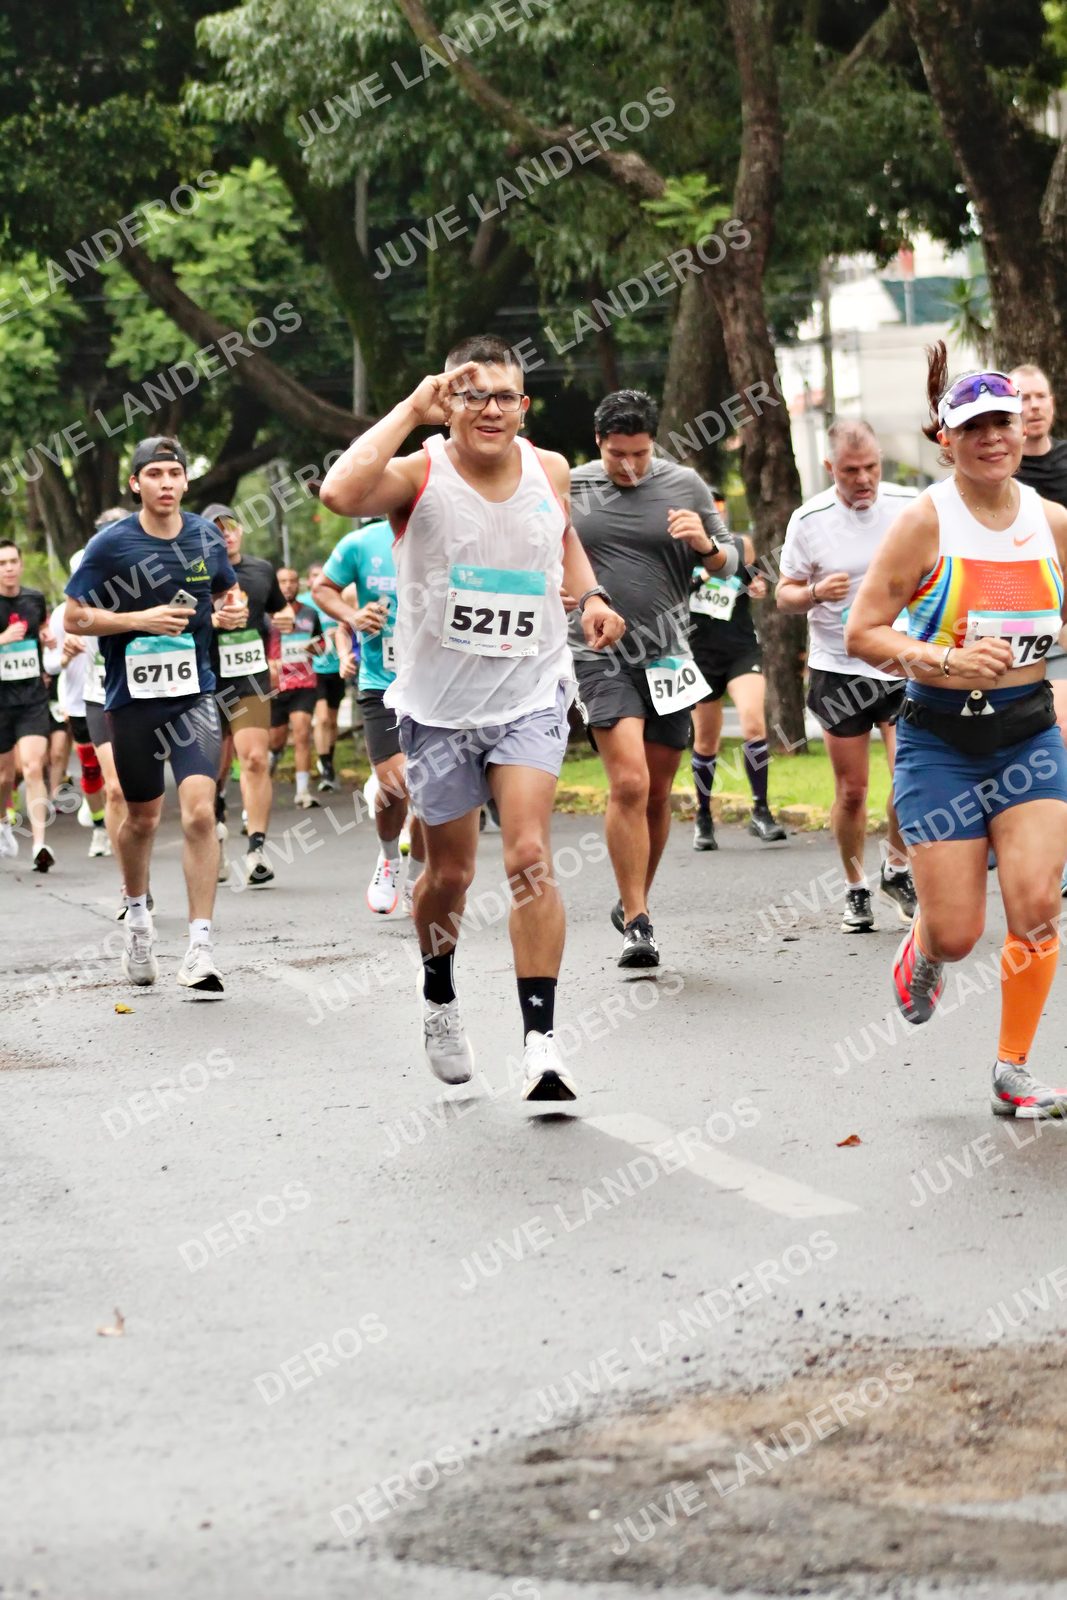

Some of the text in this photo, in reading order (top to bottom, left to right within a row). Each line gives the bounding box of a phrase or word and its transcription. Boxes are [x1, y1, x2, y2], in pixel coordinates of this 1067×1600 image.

[450, 605, 535, 637] 5215
[4, 658, 36, 670] 4140
[225, 649, 262, 666] 1582
[133, 661, 192, 684] 6716
